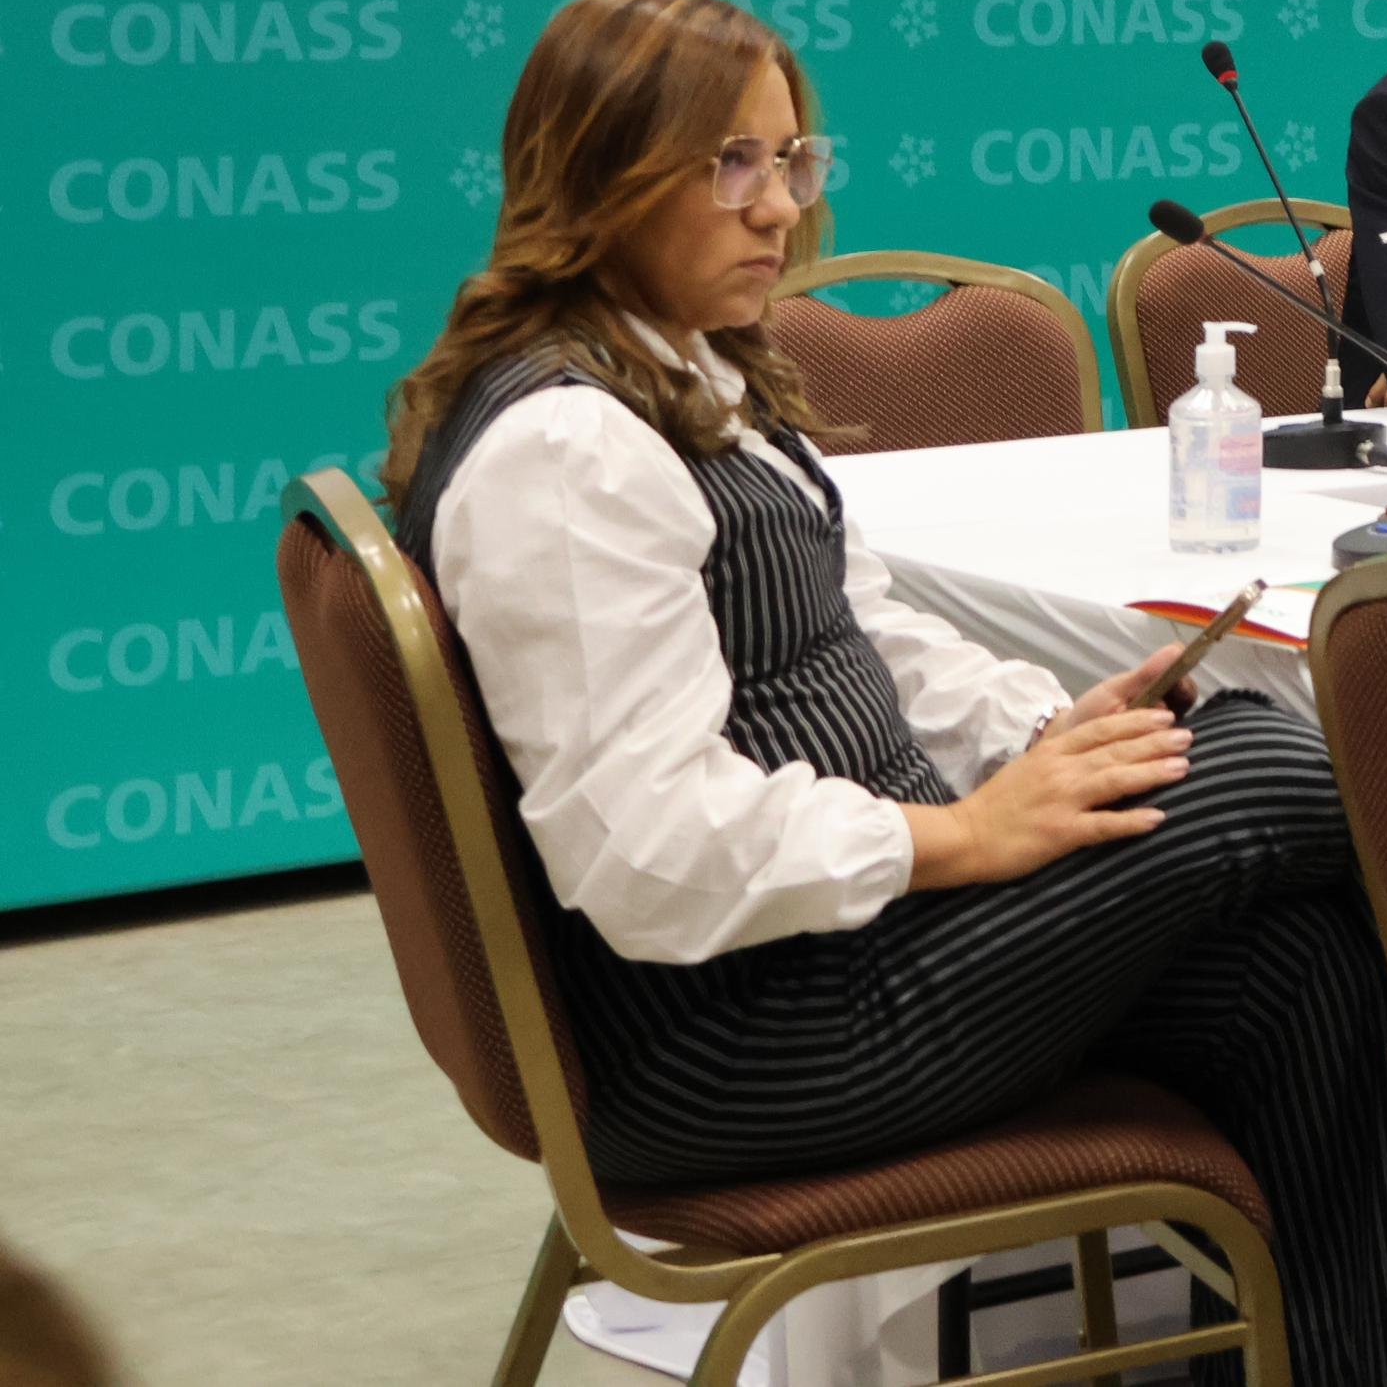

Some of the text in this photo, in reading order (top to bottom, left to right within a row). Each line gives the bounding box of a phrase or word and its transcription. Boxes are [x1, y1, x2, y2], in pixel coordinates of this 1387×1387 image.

[50, 0, 401, 66] CONASS
[48, 149, 401, 223] CONASS
[970, 121, 1242, 186] CONASS
[50, 299, 401, 380] CONASS
[48, 451, 388, 535] CONA
[48, 611, 299, 692] CONA
[46, 759, 347, 850] CONAS
